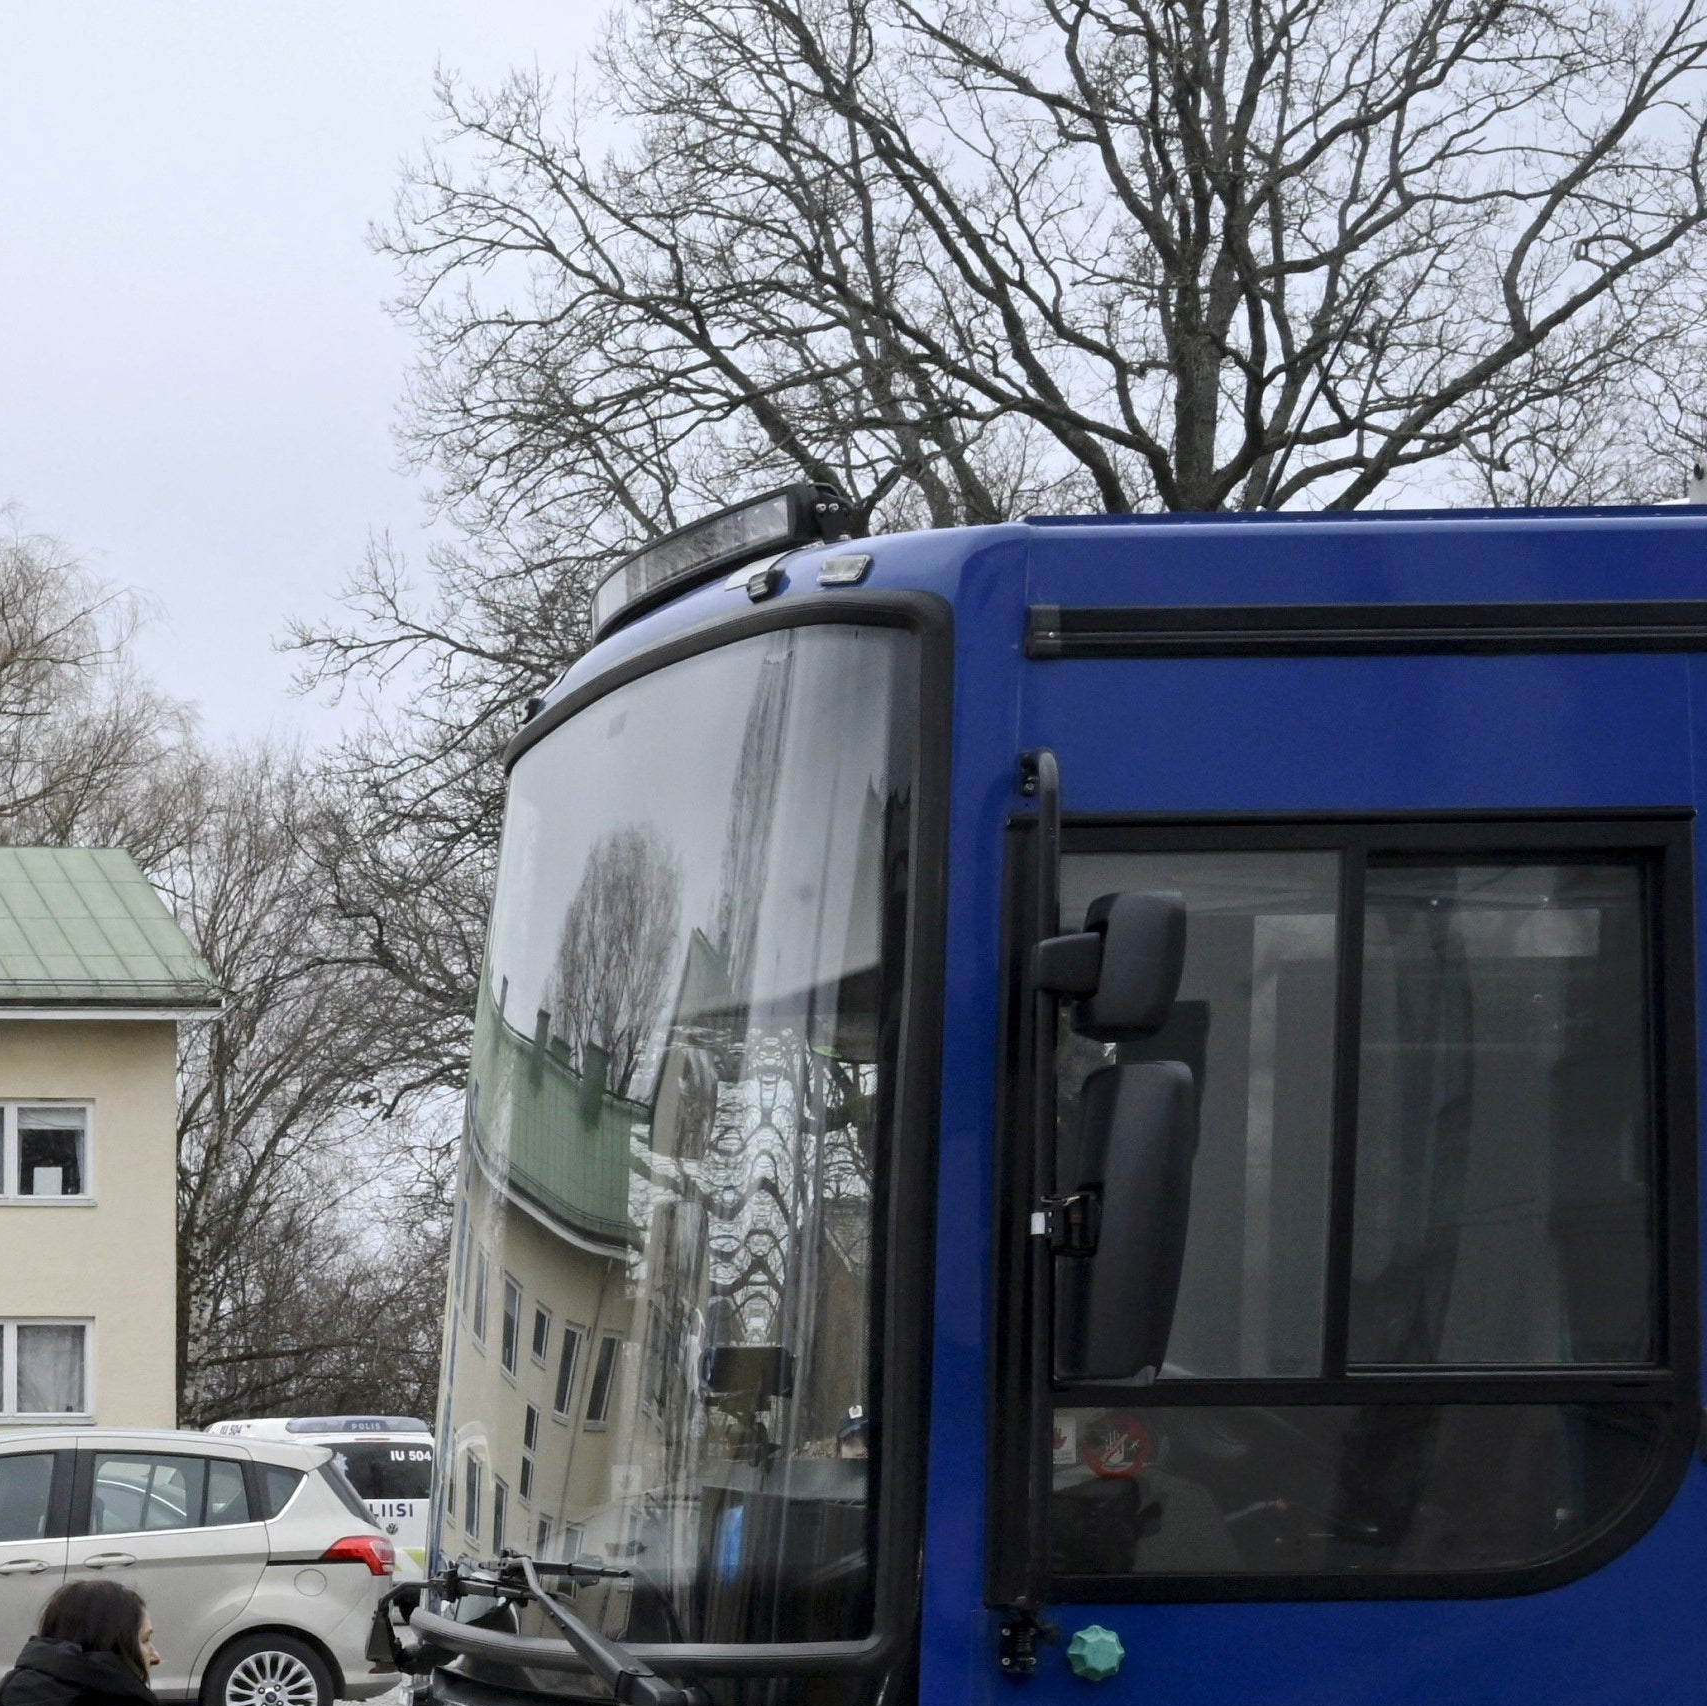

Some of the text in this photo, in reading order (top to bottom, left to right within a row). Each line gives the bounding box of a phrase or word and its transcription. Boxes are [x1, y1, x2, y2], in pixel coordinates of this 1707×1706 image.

[351, 1422, 381, 1430] POLIS
[390, 1450, 432, 1462] IU 504
